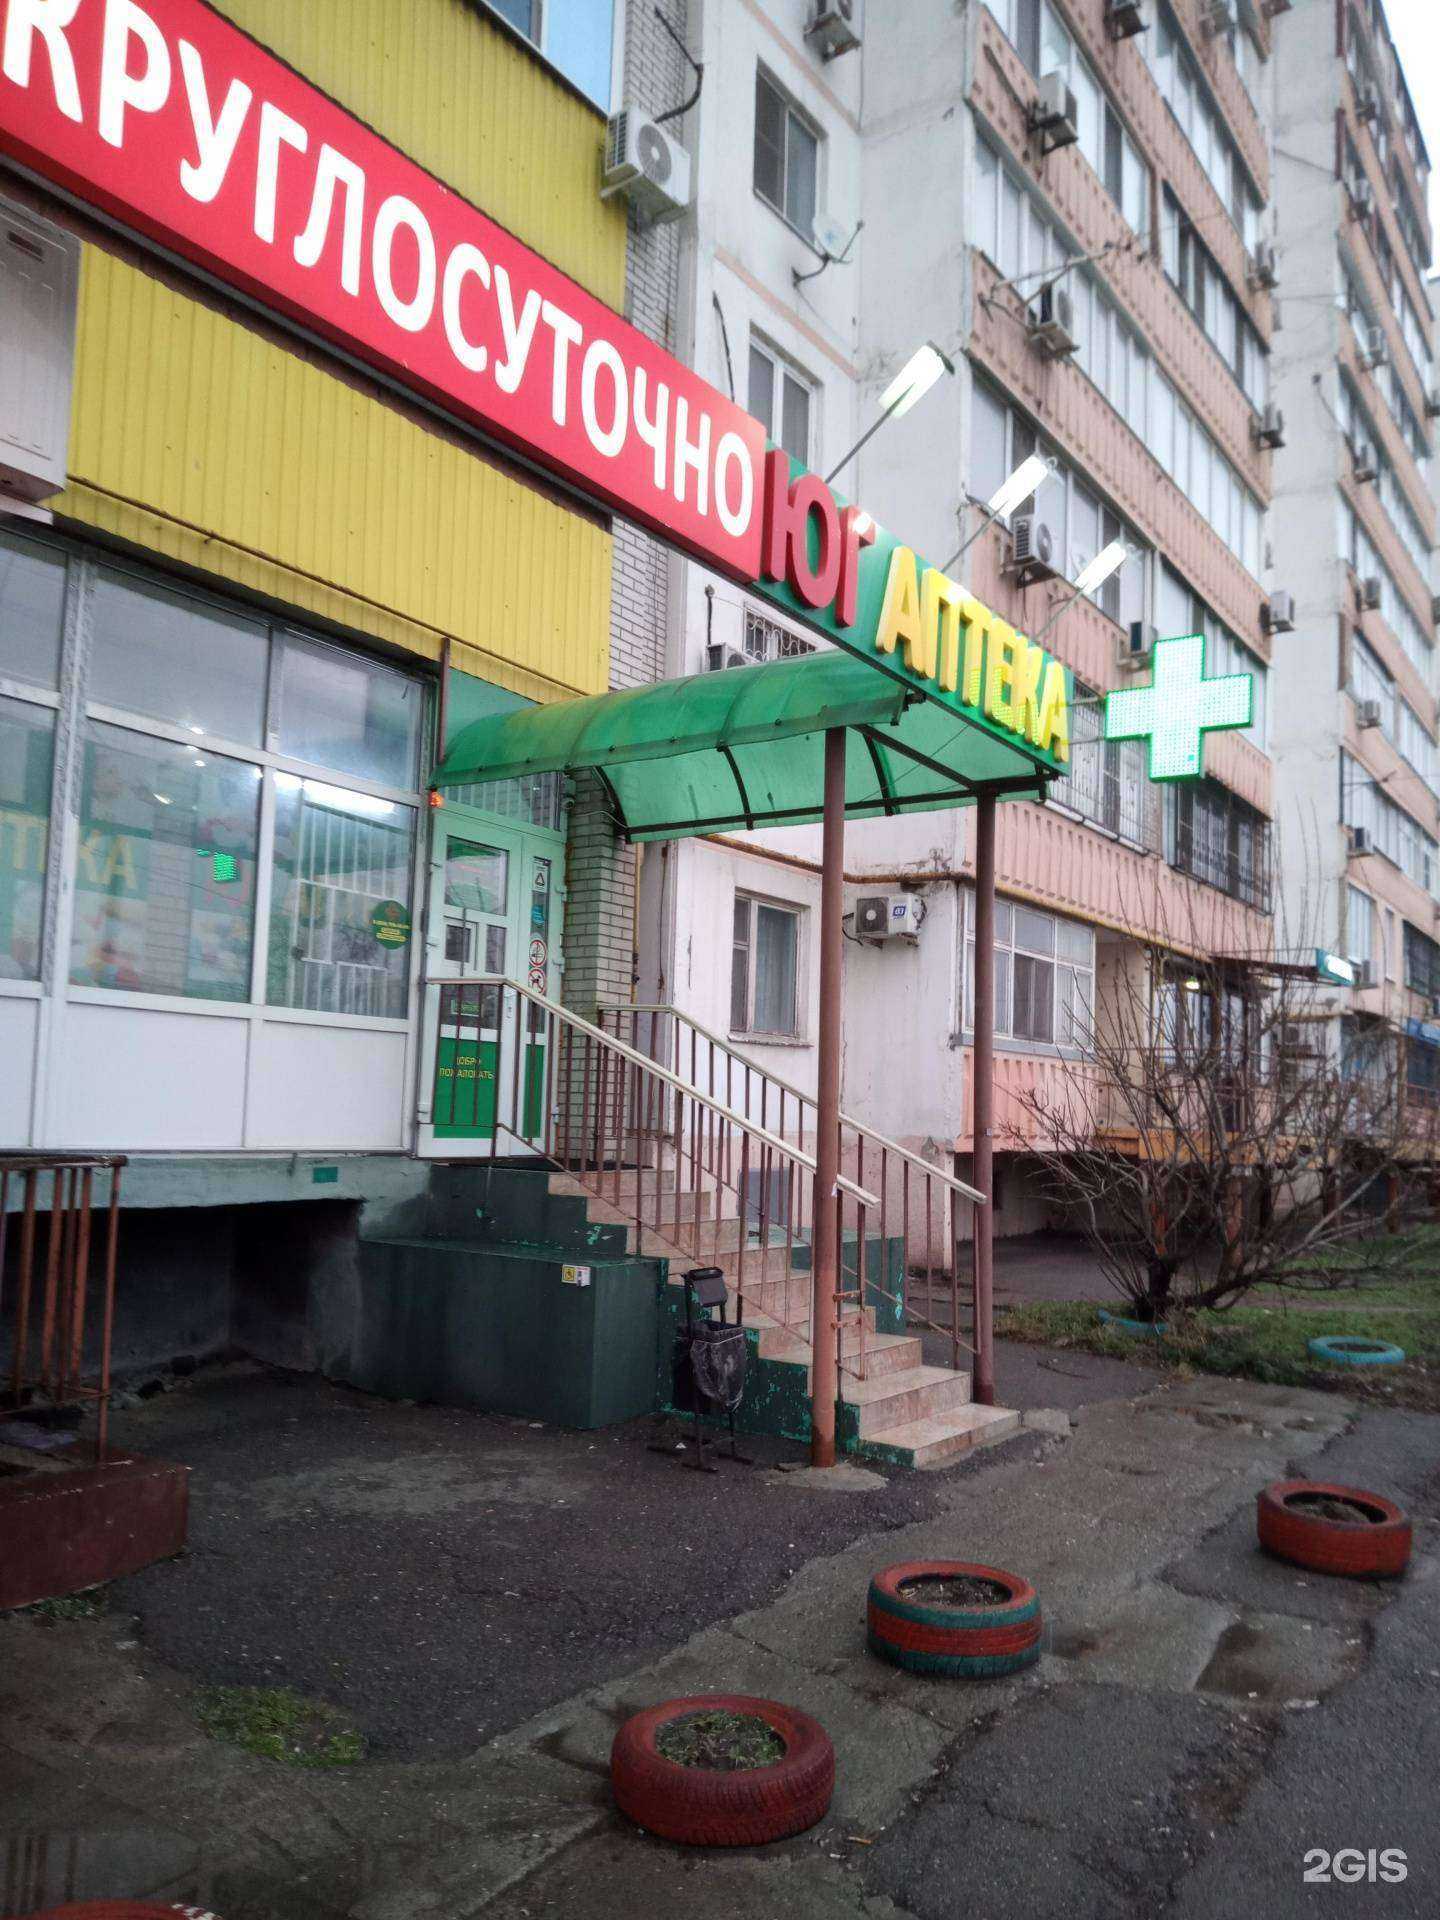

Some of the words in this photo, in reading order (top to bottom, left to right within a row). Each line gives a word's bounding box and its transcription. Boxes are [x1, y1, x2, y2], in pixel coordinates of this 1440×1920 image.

[3, 0, 754, 537] КРУГЛОСУТОЧНО
[762, 449, 875, 627] ЮГ
[876, 546, 1069, 763] АПТЕКА
